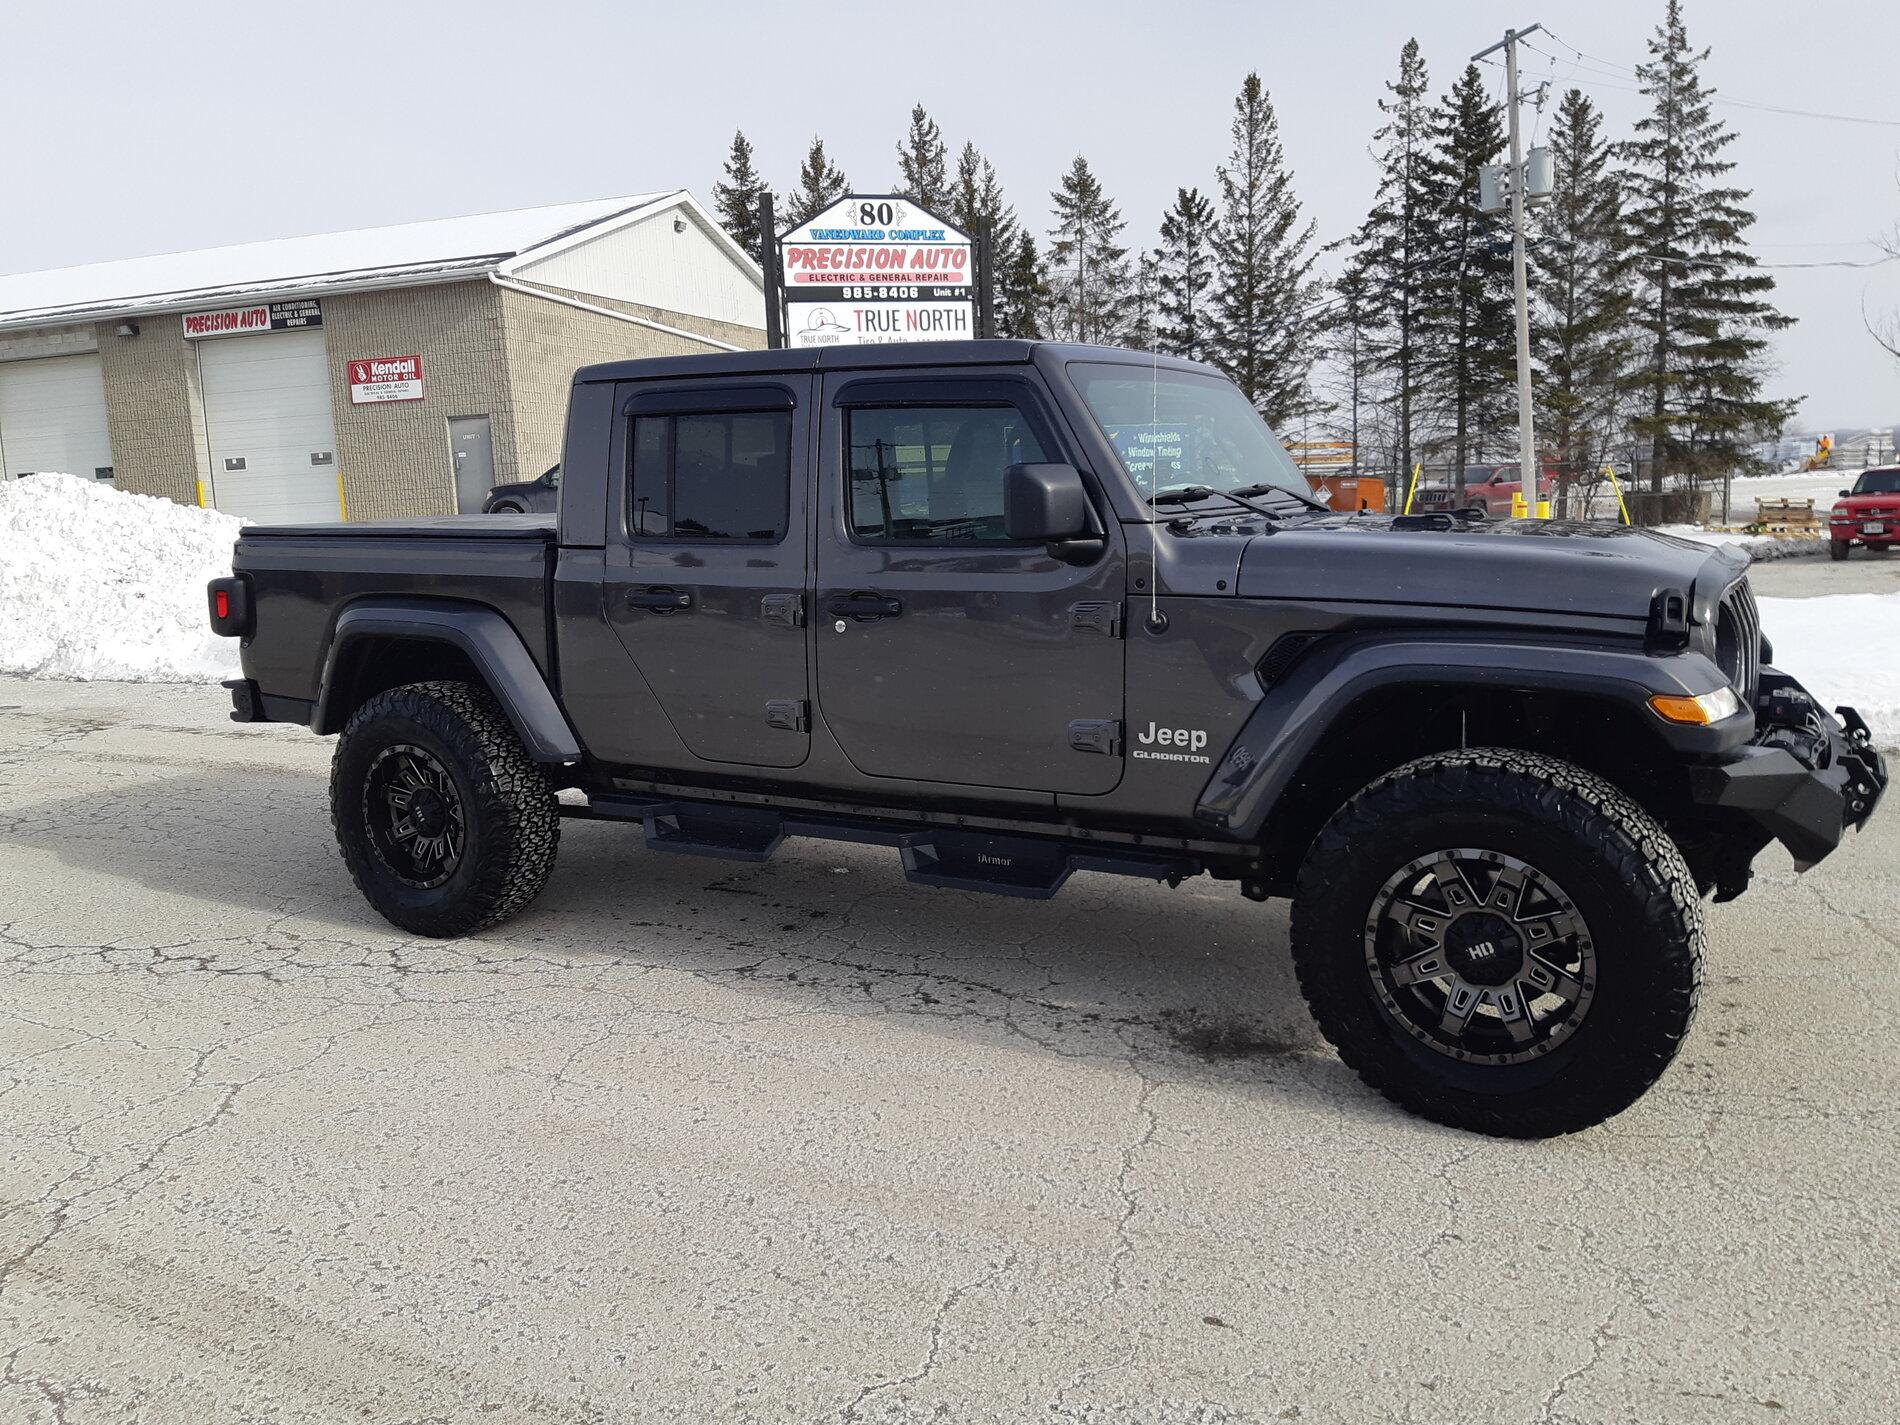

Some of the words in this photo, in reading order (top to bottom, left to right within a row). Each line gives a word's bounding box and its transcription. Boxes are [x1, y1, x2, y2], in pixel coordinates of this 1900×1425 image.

[860, 203, 893, 225] 80
[809, 229, 885, 240] VANEDWARD
[888, 230, 945, 240] COMPLEX
[787, 248, 906, 270] PRECISION
[910, 248, 967, 269] AUTO
[842, 287, 918, 299] 985-8406
[933, 288, 952, 297] Unit
[954, 288, 965, 297] #1
[185, 312, 239, 334] PRECISION
[240, 308, 267, 329] AUTO
[272, 311, 293, 320] ELECTRIC
[300, 308, 321, 317] GENERAL
[853, 309, 900, 332] TRUE
[906, 309, 966, 331] NORTH
[287, 318, 307, 326] REPAIRS
[800, 335, 816, 344] TRUE
[818, 335, 840, 344] NORTH
[371, 360, 415, 375] Kendall
[362, 383, 392, 391] PRECISION
[1138, 721, 1207, 752] Jeep
[1132, 750, 1210, 764] GLADIATOR
[977, 853, 1012, 866] iArmor
[1468, 941, 1495, 960] HD
